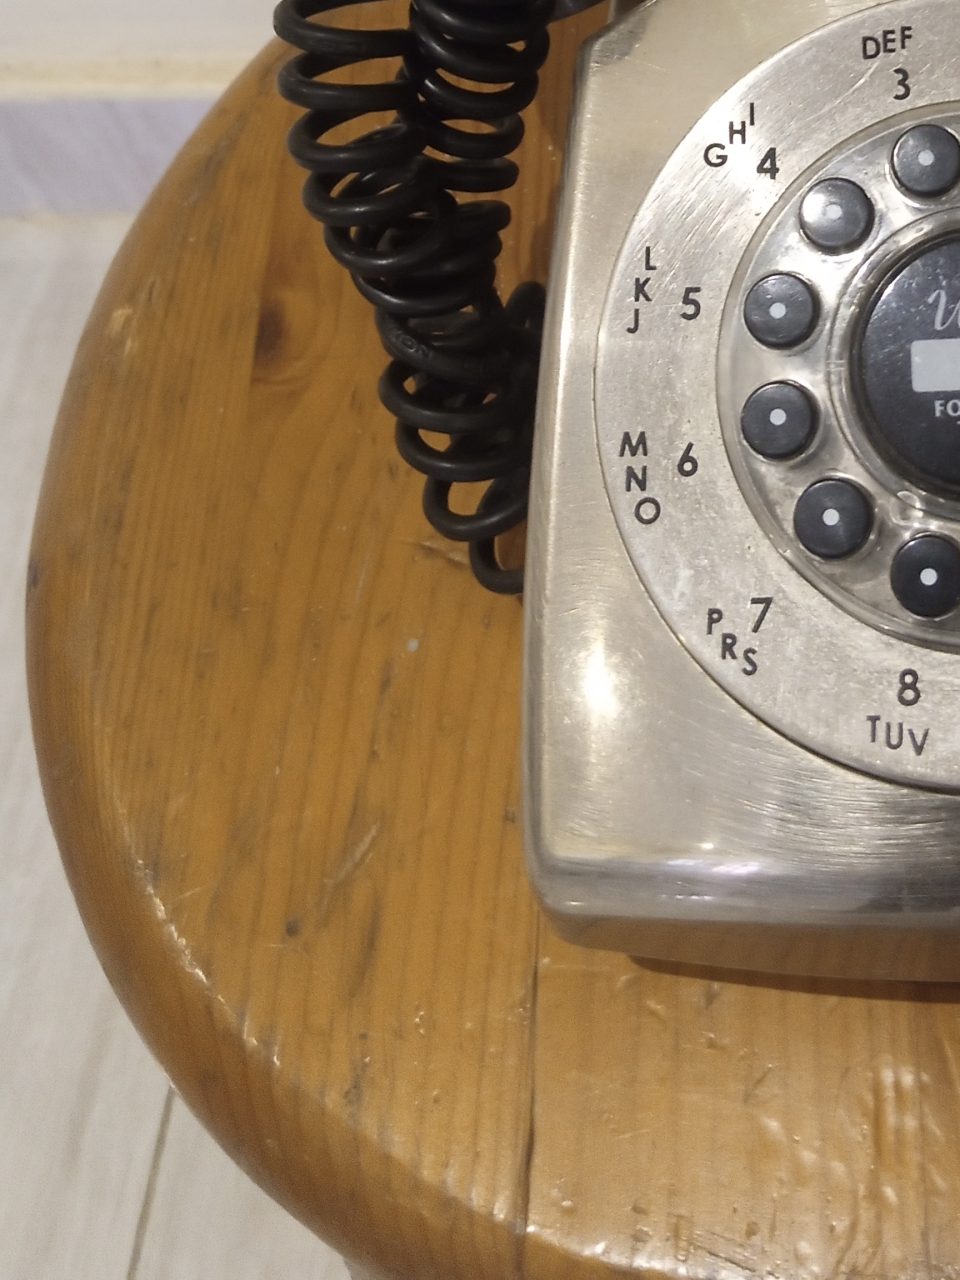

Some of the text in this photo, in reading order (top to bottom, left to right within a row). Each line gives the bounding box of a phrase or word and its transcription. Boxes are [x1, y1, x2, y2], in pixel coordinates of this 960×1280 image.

[861, 26, 913, 60] DEF
[892, 68, 912, 101] 3
[756, 147, 780, 180] 4
[680, 287, 701, 320] 5
[677, 442, 699, 477] 6
[750, 597, 773, 633] 7
[706, 608, 758, 676] PRS
[897, 668, 921, 706] 8
[866, 715, 930, 756] TUV
